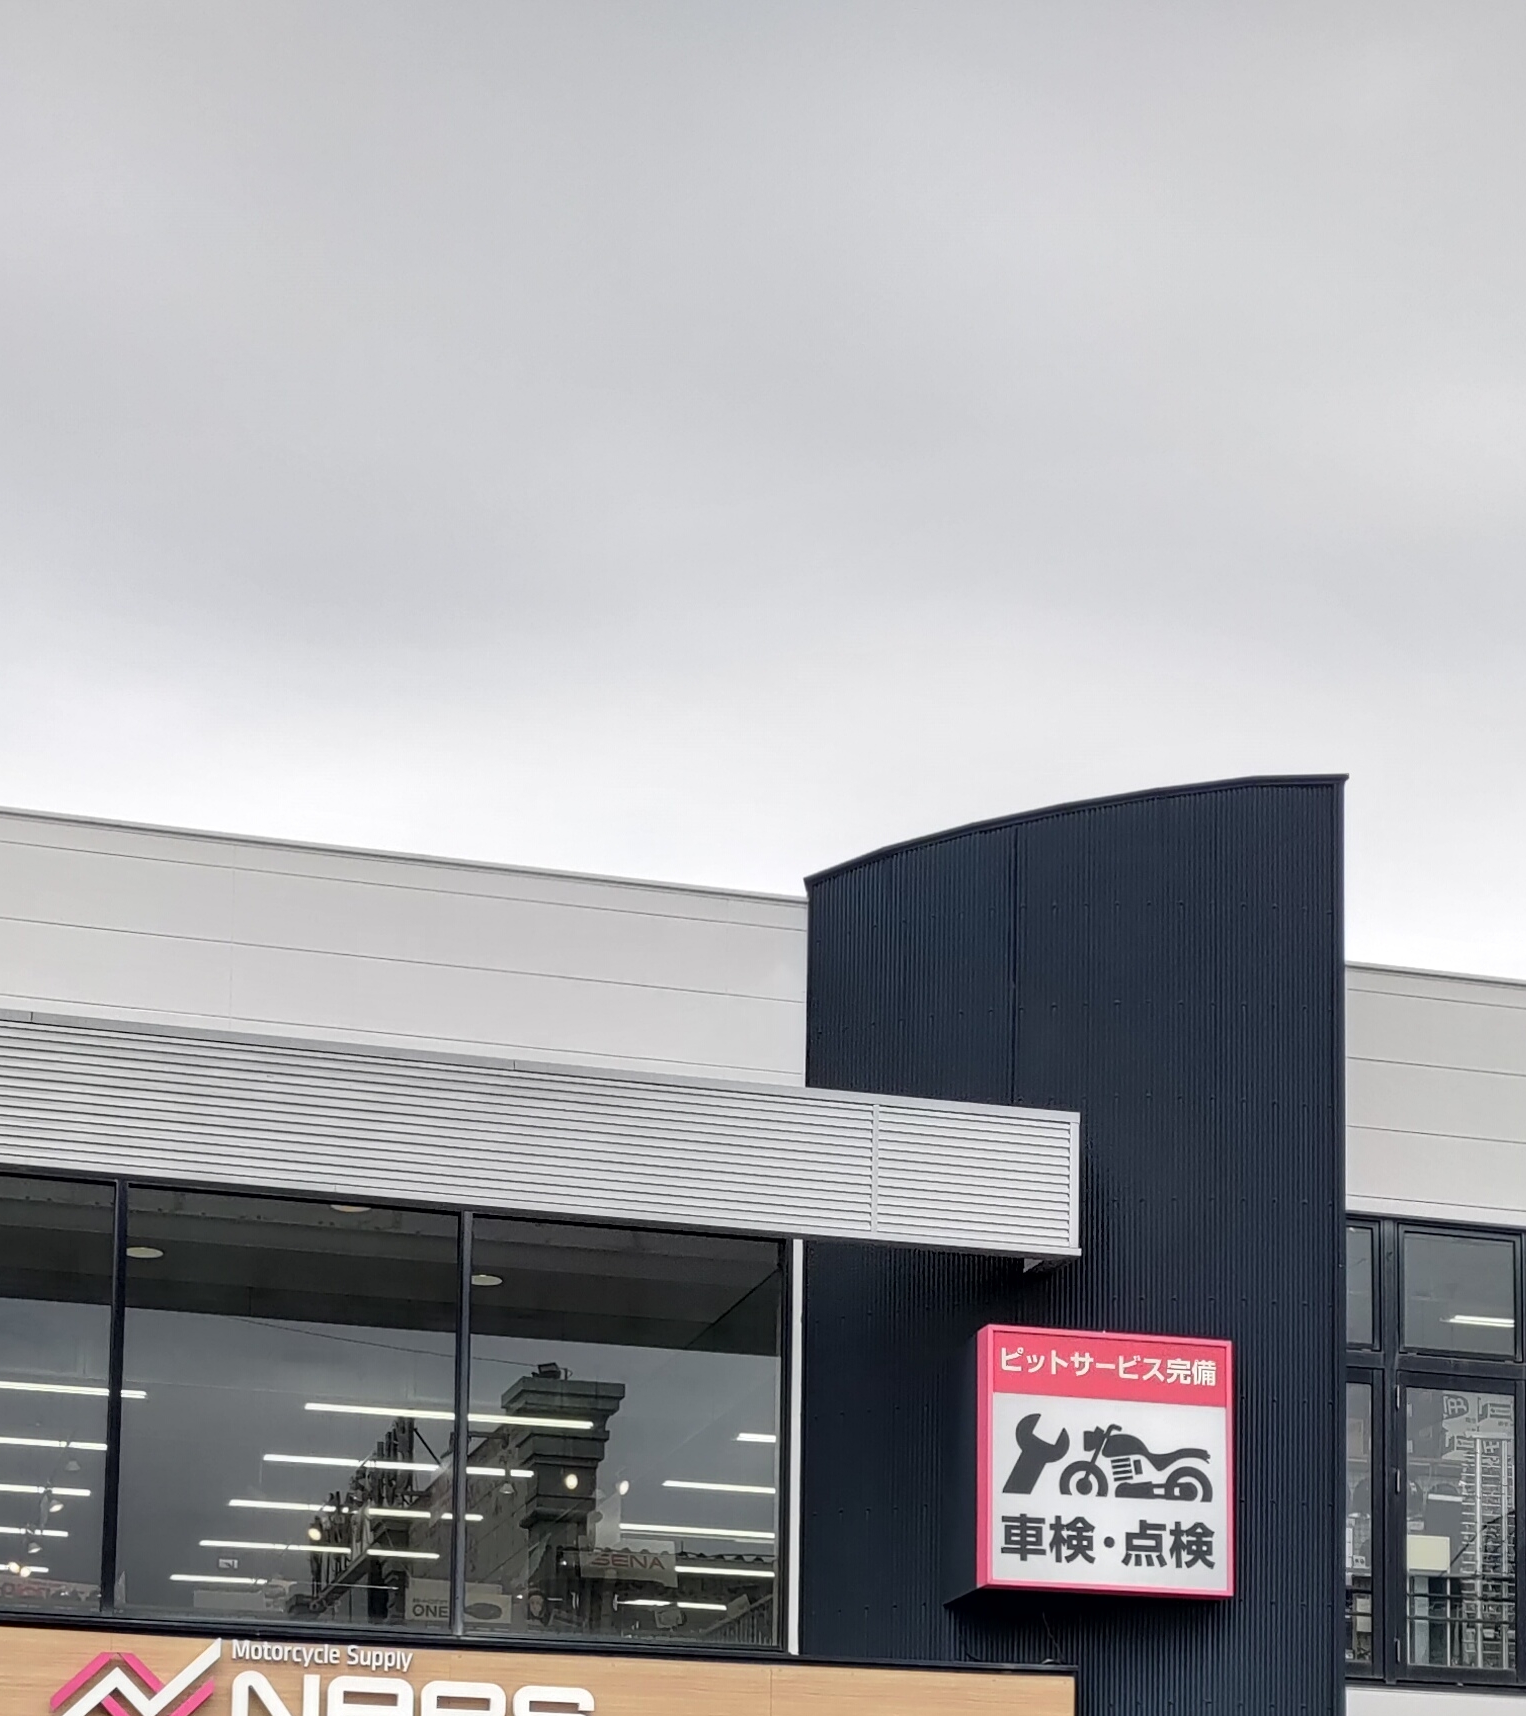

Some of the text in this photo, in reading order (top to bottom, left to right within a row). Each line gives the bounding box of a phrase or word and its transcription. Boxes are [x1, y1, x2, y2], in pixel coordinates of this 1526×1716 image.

[1000, 1347, 1217, 1387] ピットサービス完備
[1001, 1513, 1215, 1570] 車検・点検
[591, 1554, 665, 1570] SENA
[412, 1604, 448, 1618] ONE
[231, 1639, 413, 1672] Motorcycle Supply
